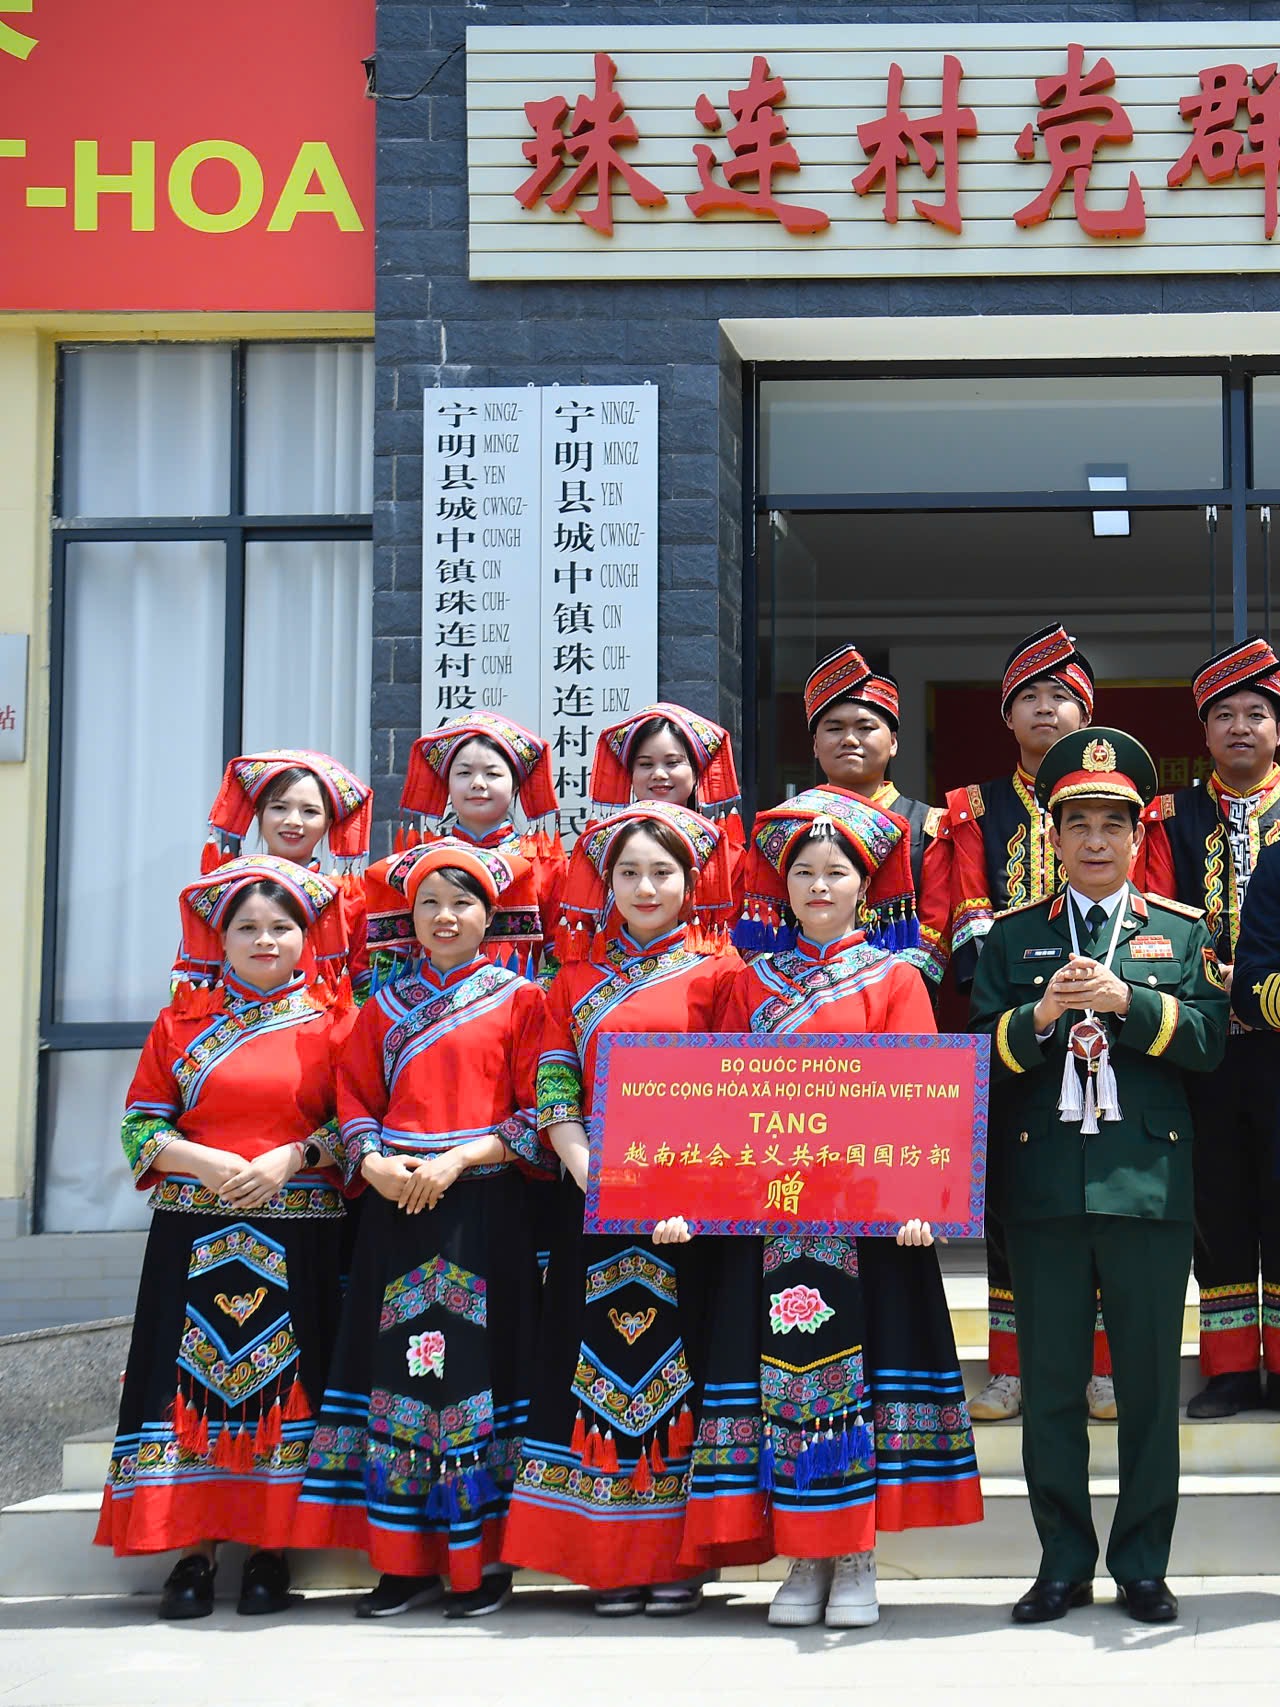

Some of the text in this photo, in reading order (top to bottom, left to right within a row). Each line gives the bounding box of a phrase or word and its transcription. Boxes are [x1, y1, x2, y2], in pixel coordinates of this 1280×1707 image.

[483, 402, 523, 423] NINGZ-
[483, 434, 519, 454] MINGZ
[483, 465, 505, 484] YEN
[483, 496, 528, 516] CWNGZ-
[483, 528, 520, 547] CUNGH
[435, 401, 478, 727] 宁明县城中镇珠连村股
[600, 401, 645, 712] NINGZ- MINGZ YEN CWNGZ- CUNGH CIN CUH- LENZ
[483, 560, 501, 579] CIN
[482, 592, 510, 611] CUH-
[482, 624, 510, 643] LENZ
[481, 655, 512, 675] CUNH
[721, 1057, 744, 1076] BỘ
[802, 1056, 861, 1073] PHÒNG
[622, 1080, 666, 1097] NƯỚC
[670, 1082, 713, 1100] CỘNG
[751, 1081, 771, 1097] XÃ
[840, 1081, 886, 1097] NGHĨA
[927, 1084, 960, 1098] NAM
[623, 1142, 951, 1168] 越南社会主义共和国国防部
[763, 1171, 805, 1215] 赠
